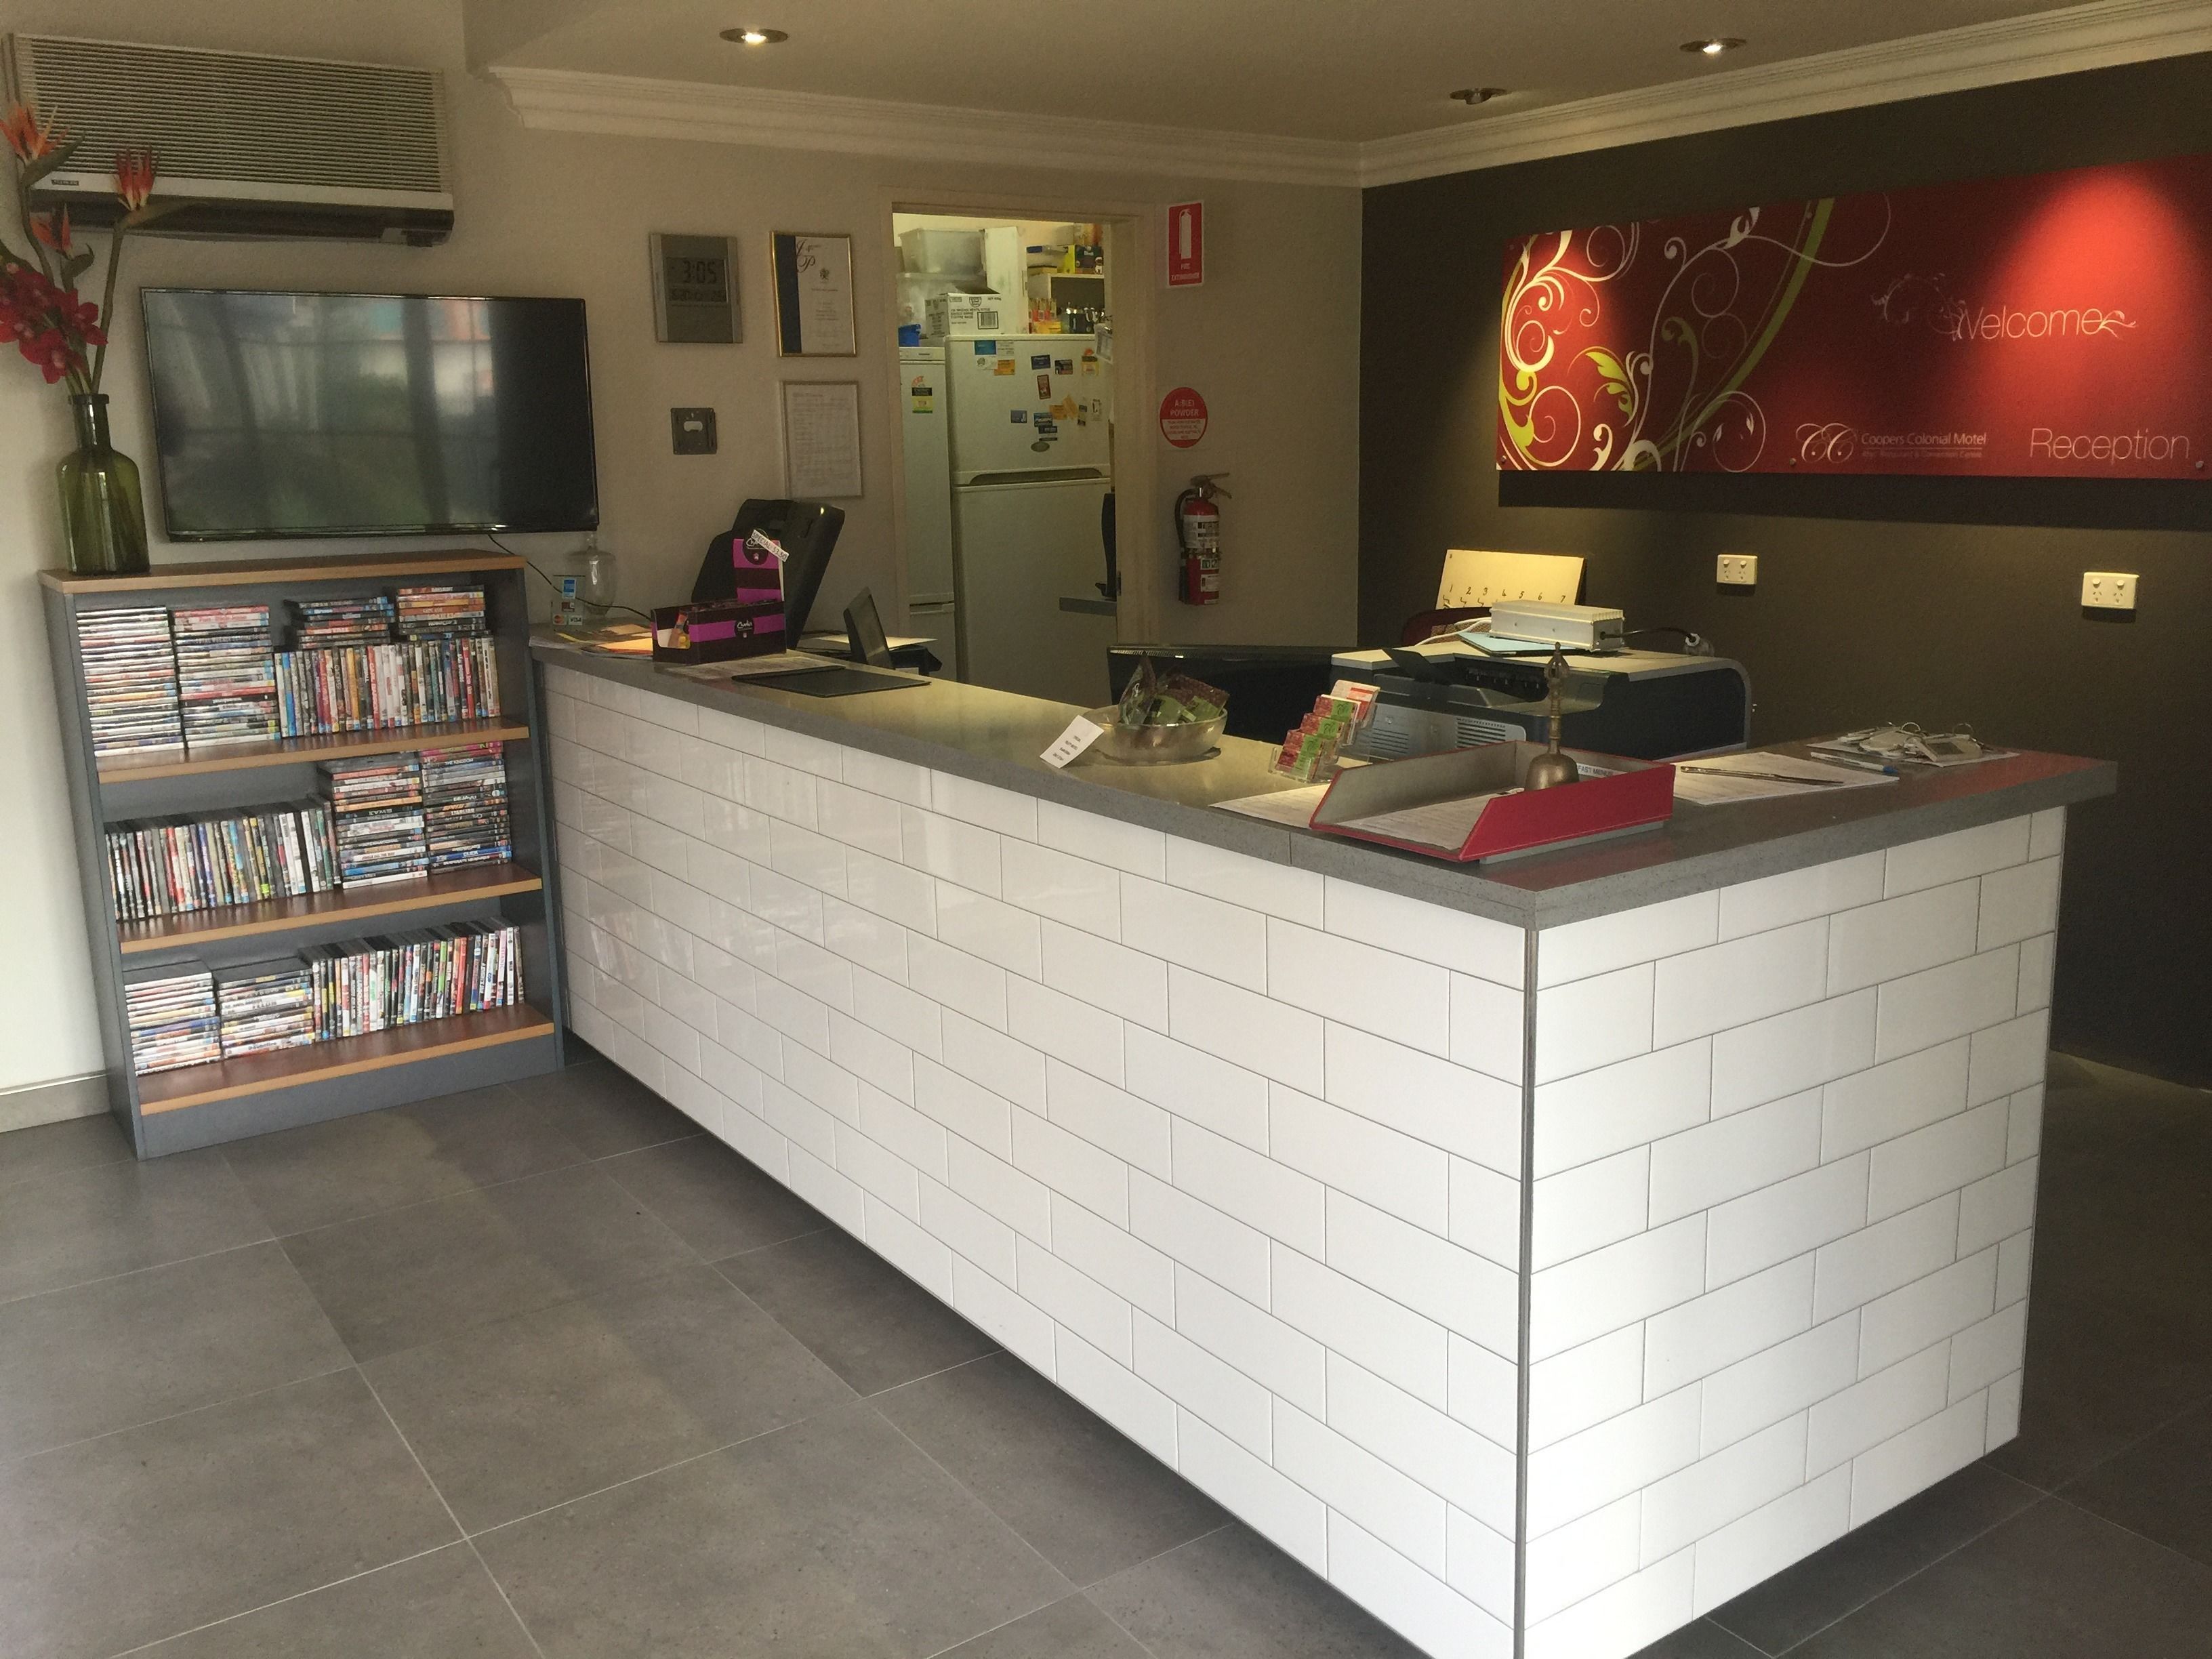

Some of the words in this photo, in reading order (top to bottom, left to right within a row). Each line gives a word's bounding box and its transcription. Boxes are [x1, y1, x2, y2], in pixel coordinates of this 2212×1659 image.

[1959, 305, 2103, 339] Welcome
[1170, 409, 1199, 417] POWDER
[1862, 432, 1906, 448] Coopers
[1907, 432, 1951, 445] Colonial
[1953, 432, 1986, 445] Motel
[2030, 428, 2190, 465] Reception
[752, 531, 771, 549] SPECIAL
[1465, 586, 1472, 595] 2
[1482, 587, 1488, 596] 3
[1502, 589, 1507, 597] 4
[1519, 590, 1525, 599] 5
[1538, 592, 1542, 600] 6
[1560, 595, 1566, 603] 7
